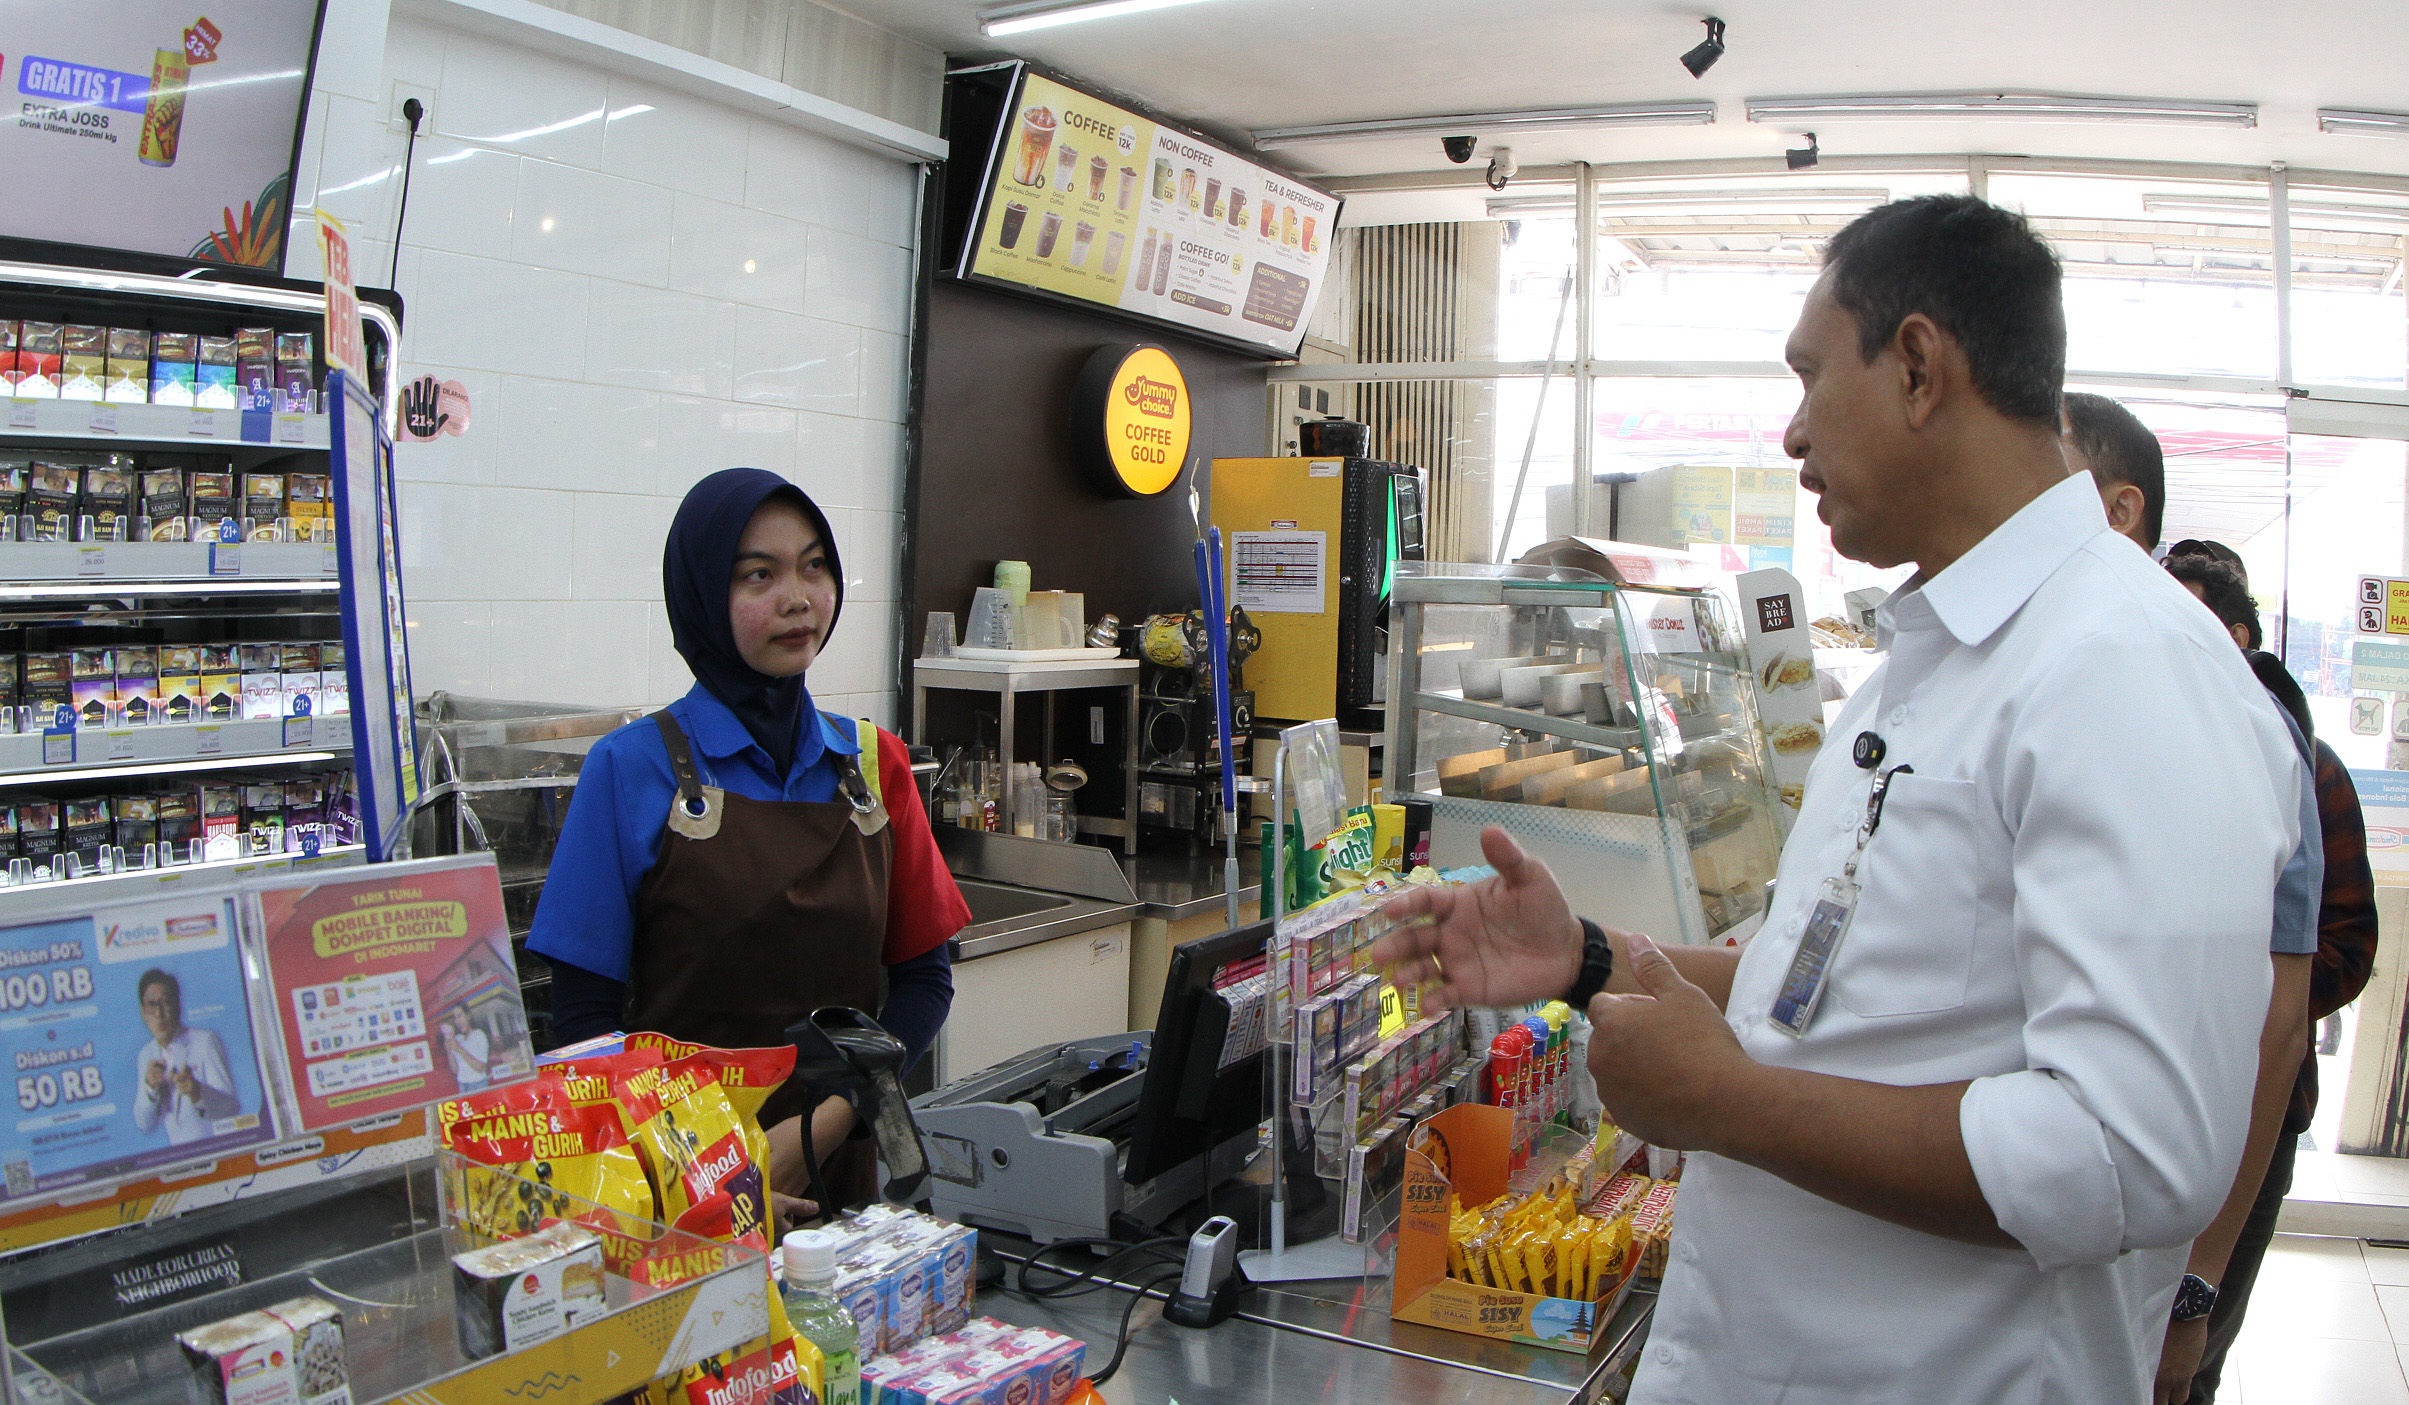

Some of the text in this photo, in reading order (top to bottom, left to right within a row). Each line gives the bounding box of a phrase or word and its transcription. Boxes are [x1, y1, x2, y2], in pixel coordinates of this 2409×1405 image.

[194, 24, 217, 46] HEMAT
[185, 34, 210, 59] 33%
[27, 61, 122, 104] GRATIS 1
[22, 102, 109, 128] EXTRA JOSS
[19, 119, 118, 143] Drink Ultimate 250ml klg
[1064, 111, 1116, 141] COFFEE
[1118, 136, 1131, 150] 12k
[1159, 136, 1214, 167] NON COFFEE
[1264, 179, 1324, 213] TEA & REFRESHER
[1178, 253, 1198, 265] BOTTLED
[1180, 240, 1230, 264] COFFEE GO!
[1257, 267, 1286, 282] ADDITIONAL
[1173, 291, 1196, 304] ADD ICE
[1127, 379, 1175, 404] Yummy
[256, 395, 271, 408] 21+
[410, 413, 435, 427] 21+
[1125, 423, 1171, 446] COFFEE
[1131, 444, 1165, 464] GOLD
[150, 501, 181, 513] MAGNUM
[199, 506, 228, 514] MAGNUM
[250, 507, 279, 515] MAGNUM
[223, 525, 238, 538] 21+
[1764, 599, 1785, 611] SAY
[1765, 608, 1787, 619] BRE
[1766, 617, 1782, 627] AD
[2391, 614, 2409, 626] HA
[247, 687, 276, 697] TWIZZ
[287, 686, 316, 695] TWIZZ
[328, 685, 348, 693] TWIZ
[295, 700, 310, 712] 21+
[58, 711, 74, 724] 21+
[337, 810, 362, 827] TWIZZ
[1349, 817, 1368, 829] Baru
[252, 826, 281, 836] TWIZZ
[292, 822, 322, 834] TWIZZ
[26, 839, 57, 848] MAGNUM
[76, 833, 106, 843] MAGNUM
[304, 839, 318, 851] 21+
[352, 887, 423, 907] TARIK TUNAI
[321, 902, 455, 937] MOBILE BANKING/
[329, 921, 453, 950] DOMPET DIGITAL
[50, 940, 84, 961] 50%
[354, 941, 436, 964] DI INDOMARET
[52, 966, 94, 1004] RB
[15, 1048, 69, 1071] Diskon
[565, 1065, 578, 1081] &
[661, 1067, 671, 1083] &
[17, 1065, 104, 1111] 50 RB
[563, 1076, 608, 1101] URIH
[655, 1071, 698, 1108] GURIH
[461, 1101, 474, 1118] &
[470, 1112, 549, 1143] MANIS
[550, 1115, 564, 1133] &
[258, 1151, 276, 1161] Spicy
[304, 1141, 323, 1151] Mayo
[532, 1132, 584, 1159] GURIH
[1407, 1171, 1425, 1183] Pie
[1406, 1184, 1447, 1203] SISY
[1583, 1176, 1638, 1218] SILVERQUEEN
[1630, 1183, 1678, 1232] SILVERQUEEN
[1418, 1218, 1438, 1229] HALAL
[601, 1233, 644, 1260] NIS
[112, 1242, 235, 1287] MADE FOR URBAN
[647, 1247, 724, 1286] MANIS
[116, 1260, 241, 1304] NEIGHBORHOOD
[1478, 1294, 1498, 1306] Pie
[1499, 1295, 1524, 1306] Susu
[1443, 1310, 1469, 1320] HALAL
[1479, 1306, 1523, 1324] SISY
[705, 1350, 798, 1405] Indofood
